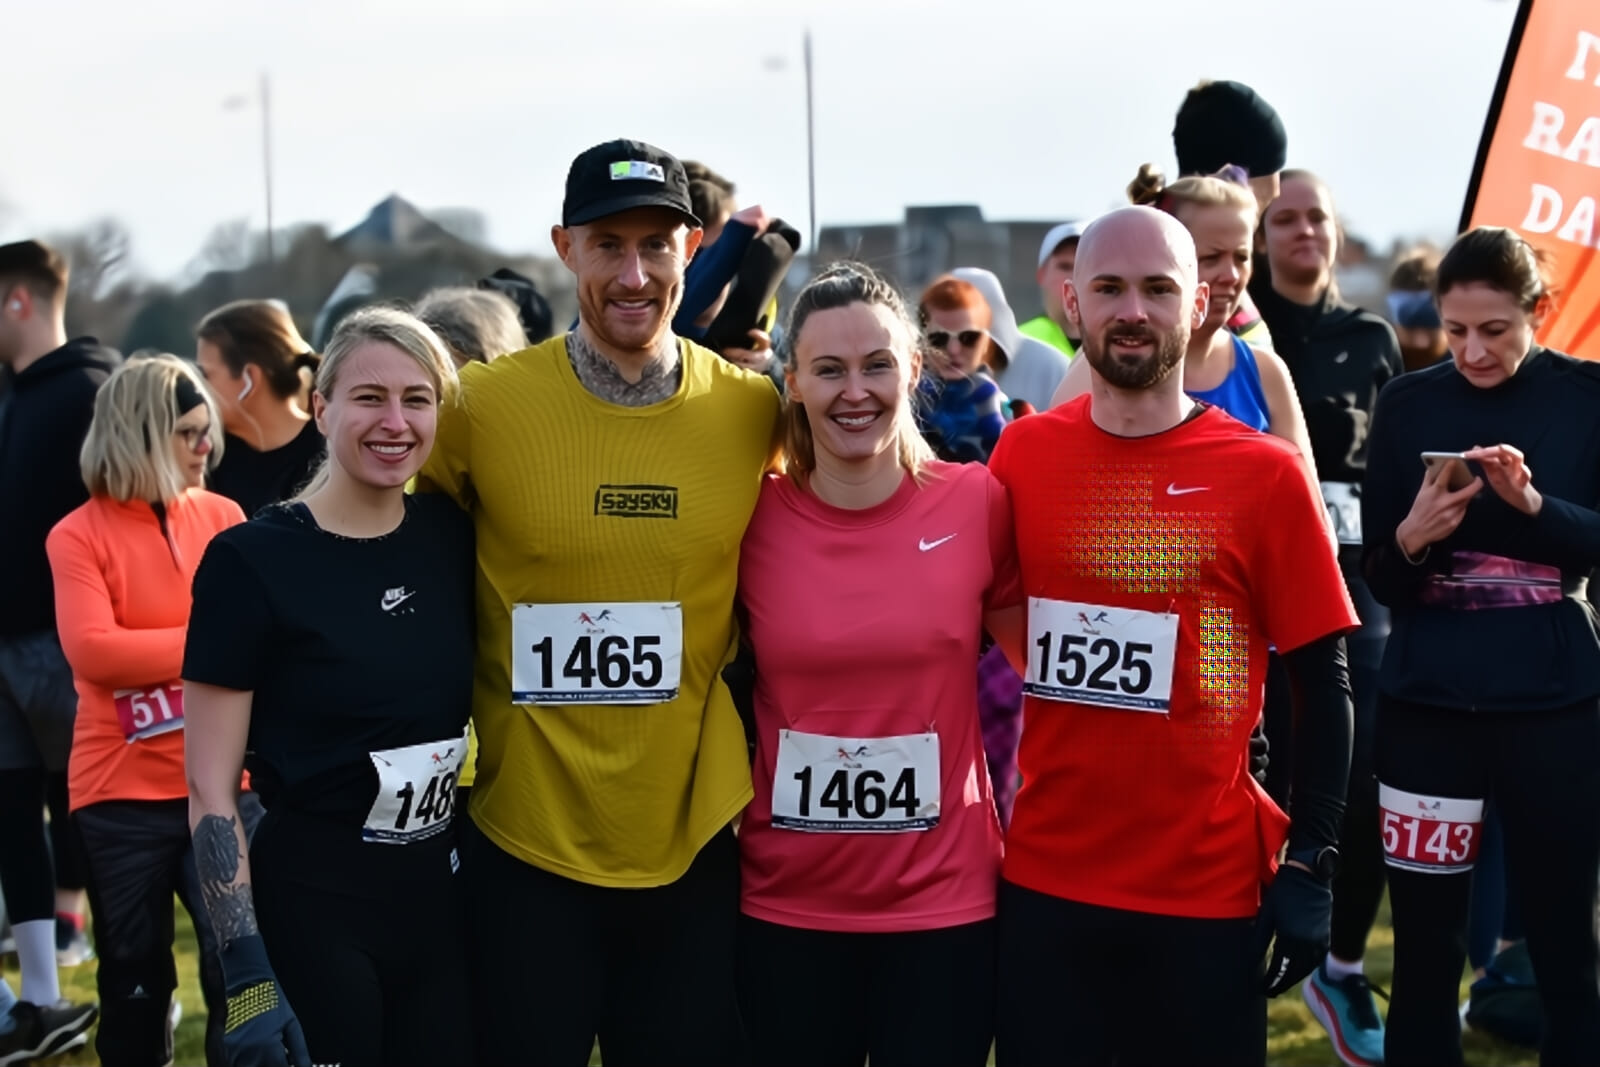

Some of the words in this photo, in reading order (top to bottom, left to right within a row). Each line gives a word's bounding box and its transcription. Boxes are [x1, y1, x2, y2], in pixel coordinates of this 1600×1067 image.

[532, 635, 663, 688] 1465
[1037, 631, 1153, 695] 1525
[394, 771, 456, 830] 148
[794, 765, 920, 819] 1464
[1383, 811, 1474, 862] 5143
